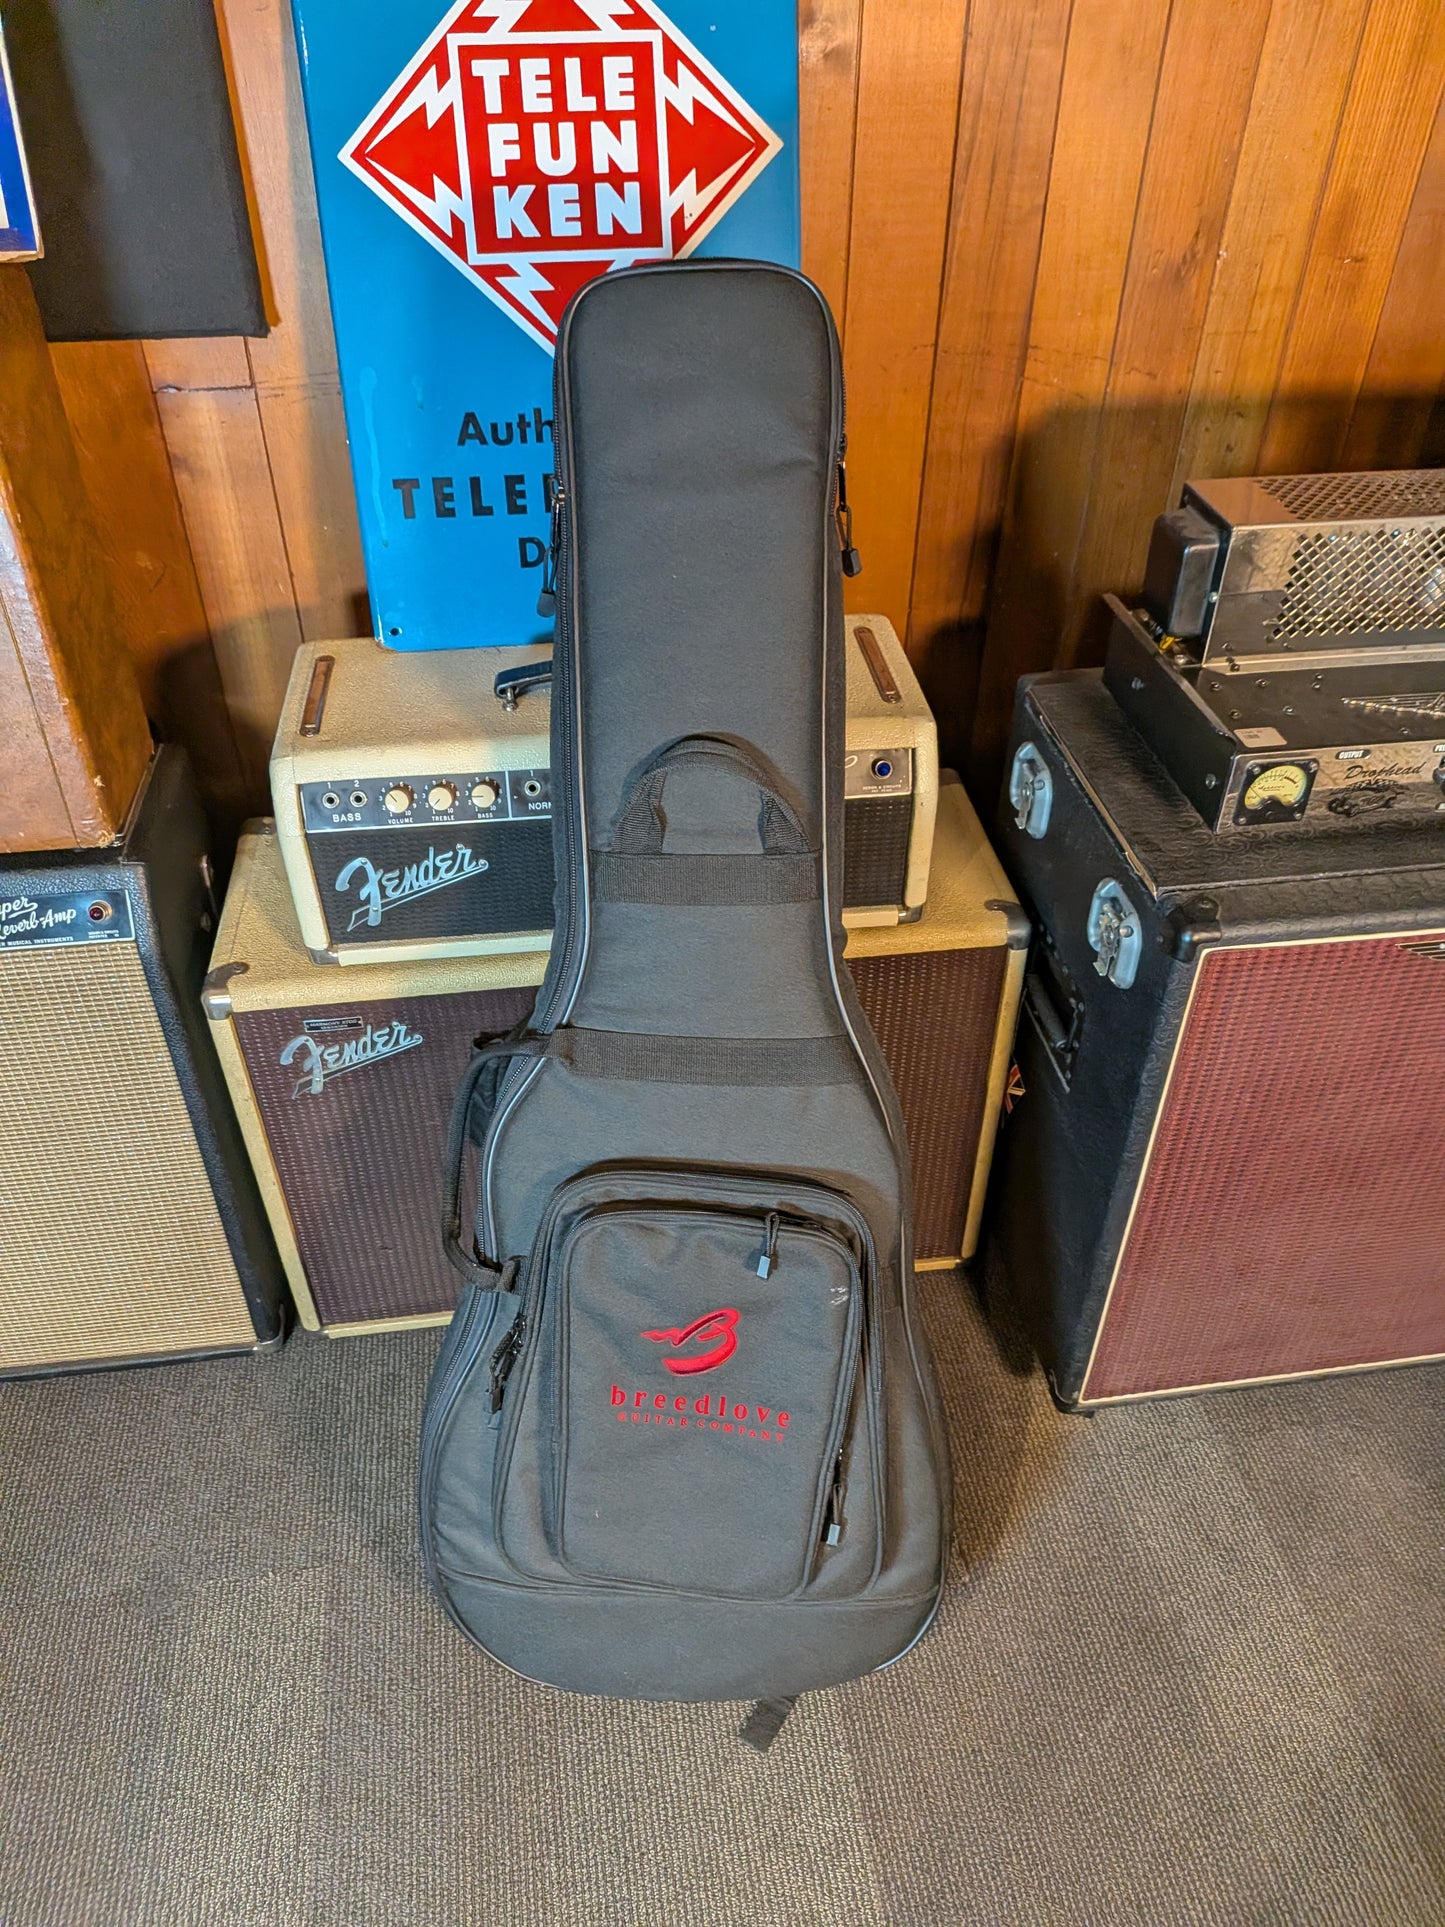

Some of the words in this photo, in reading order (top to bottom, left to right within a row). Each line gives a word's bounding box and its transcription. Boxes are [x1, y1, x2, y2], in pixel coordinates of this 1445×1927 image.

[471, 56, 635, 114] TELE
[487, 120, 639, 177] FUN
[492, 181, 643, 239] KEN
[457, 407, 554, 446] Auth
[1338, 750, 1364, 759] OUTPUT
[1344, 761, 1427, 780] Drophead
[354, 780, 360, 788] 2
[332, 812, 362, 822] BASS
[335, 844, 488, 932] Fender
[0, 896, 38, 921] per
[34, 936, 74, 944] INSTRUMENTS
[280, 1020, 423, 1100] Fender
[610, 1384, 791, 1429] breedlove
[617, 1411, 688, 1427] GUITAR
[698, 1419, 785, 1443] COMPANY
